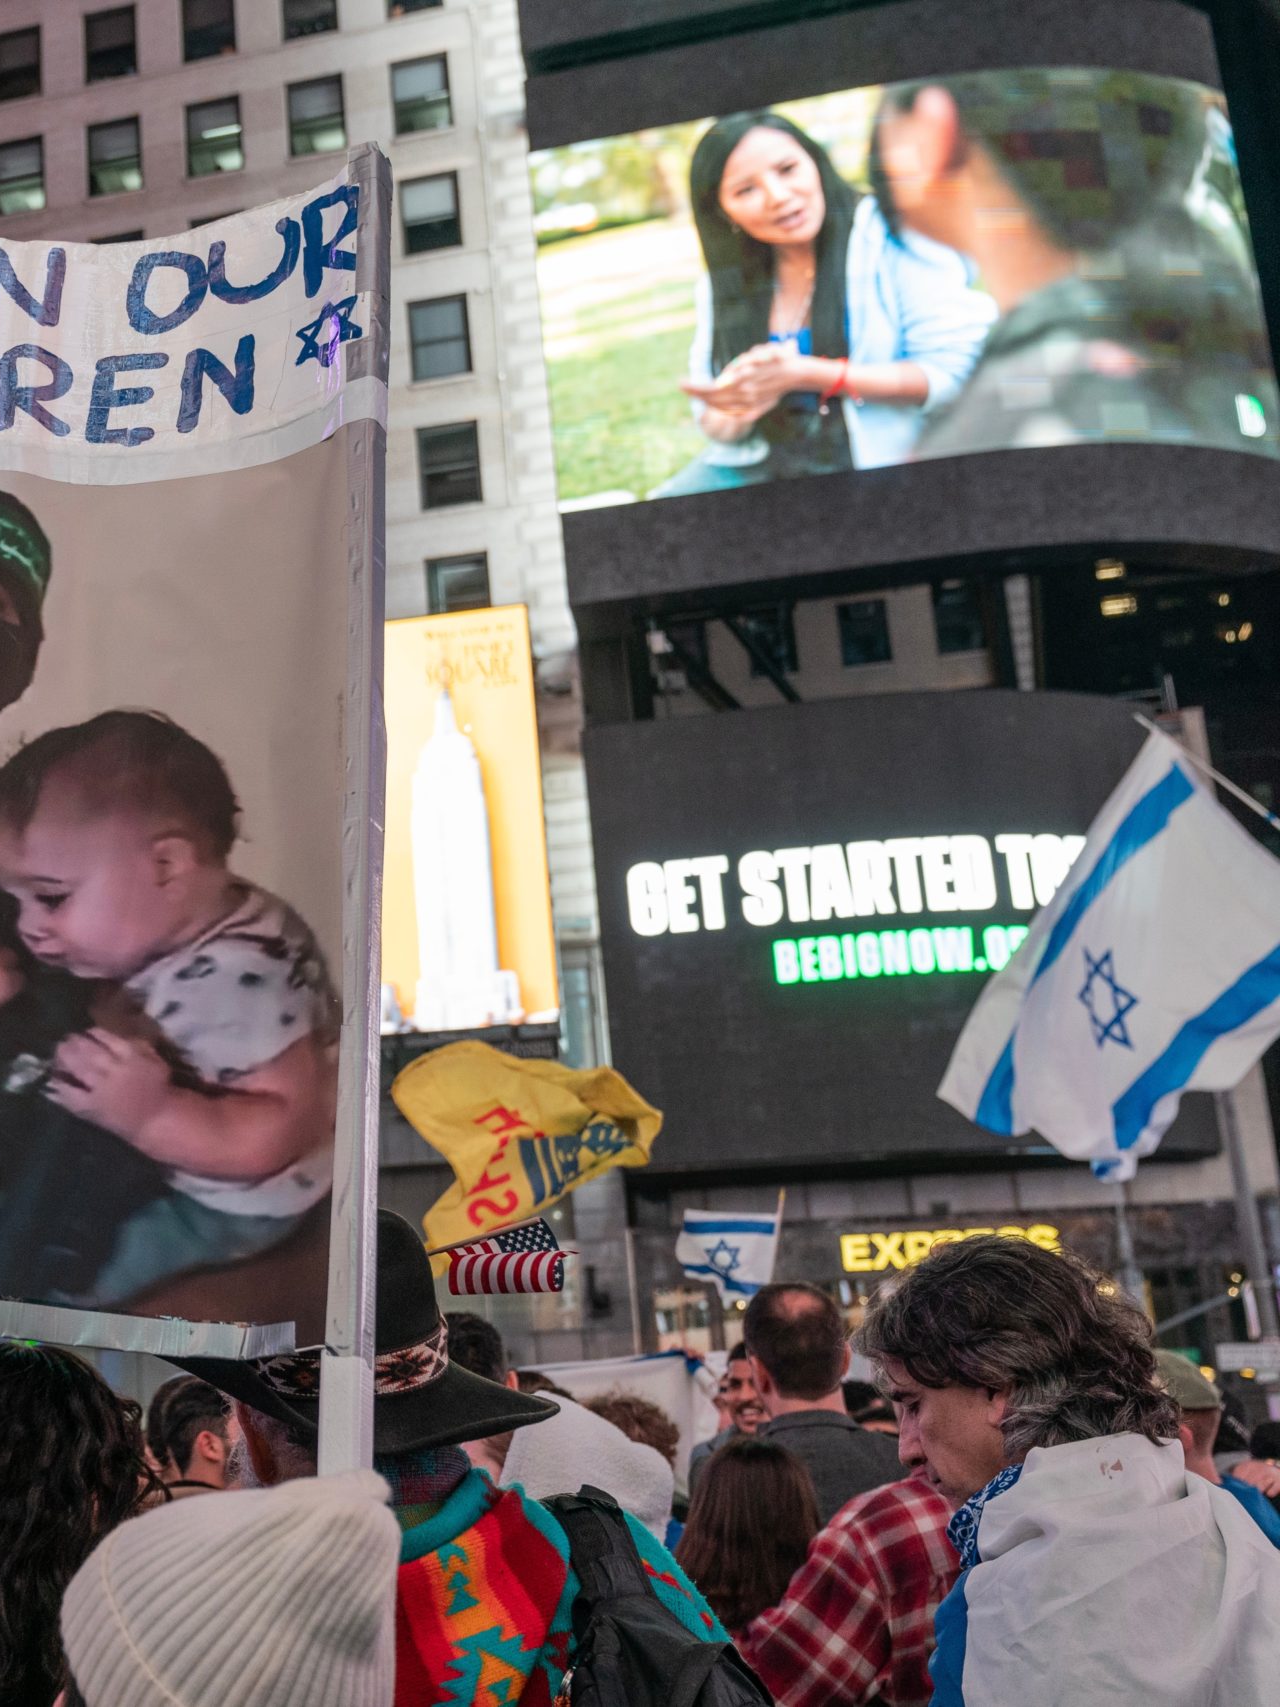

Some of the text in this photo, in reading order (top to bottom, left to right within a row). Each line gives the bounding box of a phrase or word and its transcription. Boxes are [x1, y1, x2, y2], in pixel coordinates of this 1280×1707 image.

[126, 185, 360, 335] OUR
[626, 854, 729, 937] GET
[737, 833, 998, 927] STARTED
[840, 1223, 1063, 1273] EXPS
